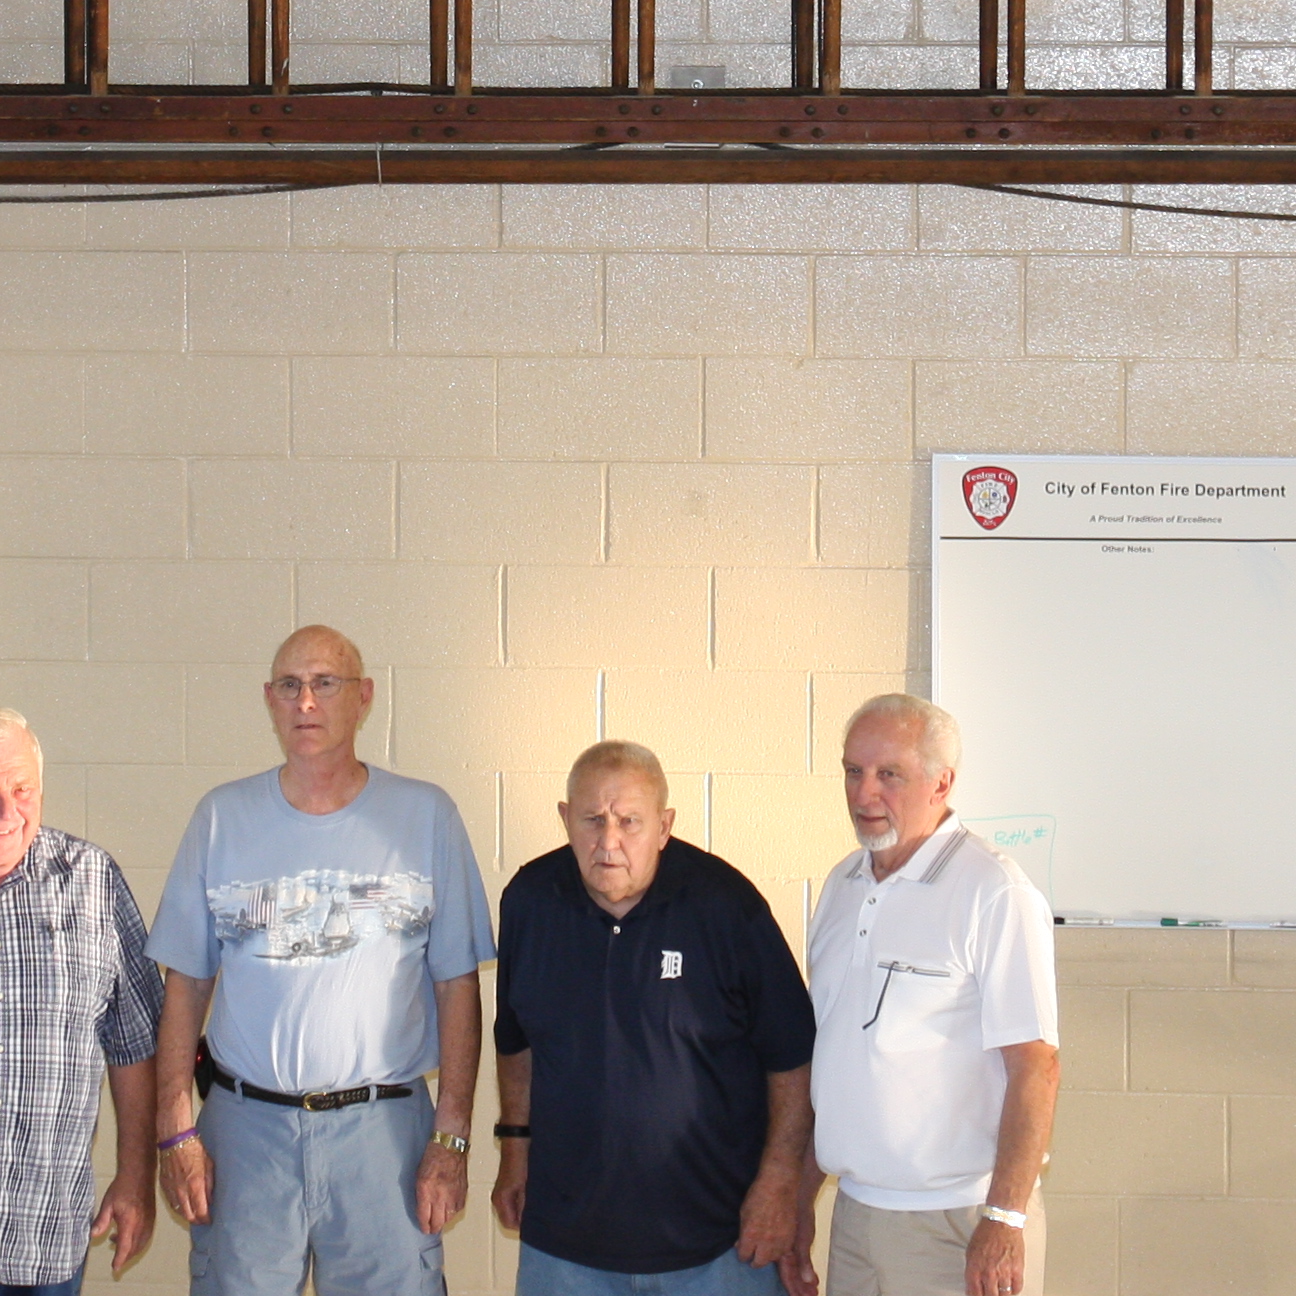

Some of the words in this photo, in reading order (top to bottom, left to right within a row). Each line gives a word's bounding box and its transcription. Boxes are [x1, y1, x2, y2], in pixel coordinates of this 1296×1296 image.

[1044, 481, 1075, 497] City
[1080, 482, 1096, 495] of
[1101, 482, 1155, 496] Fenton
[1160, 483, 1190, 496] Fire
[1195, 483, 1286, 499] Department
[1089, 515, 1097, 523] A
[1098, 515, 1124, 523] Proud
[1126, 515, 1164, 523] Tradition
[1165, 515, 1175, 523] of
[1176, 515, 1223, 524] Excellence
[1101, 545, 1125, 553] Other
[1127, 545, 1154, 554] Notes:
